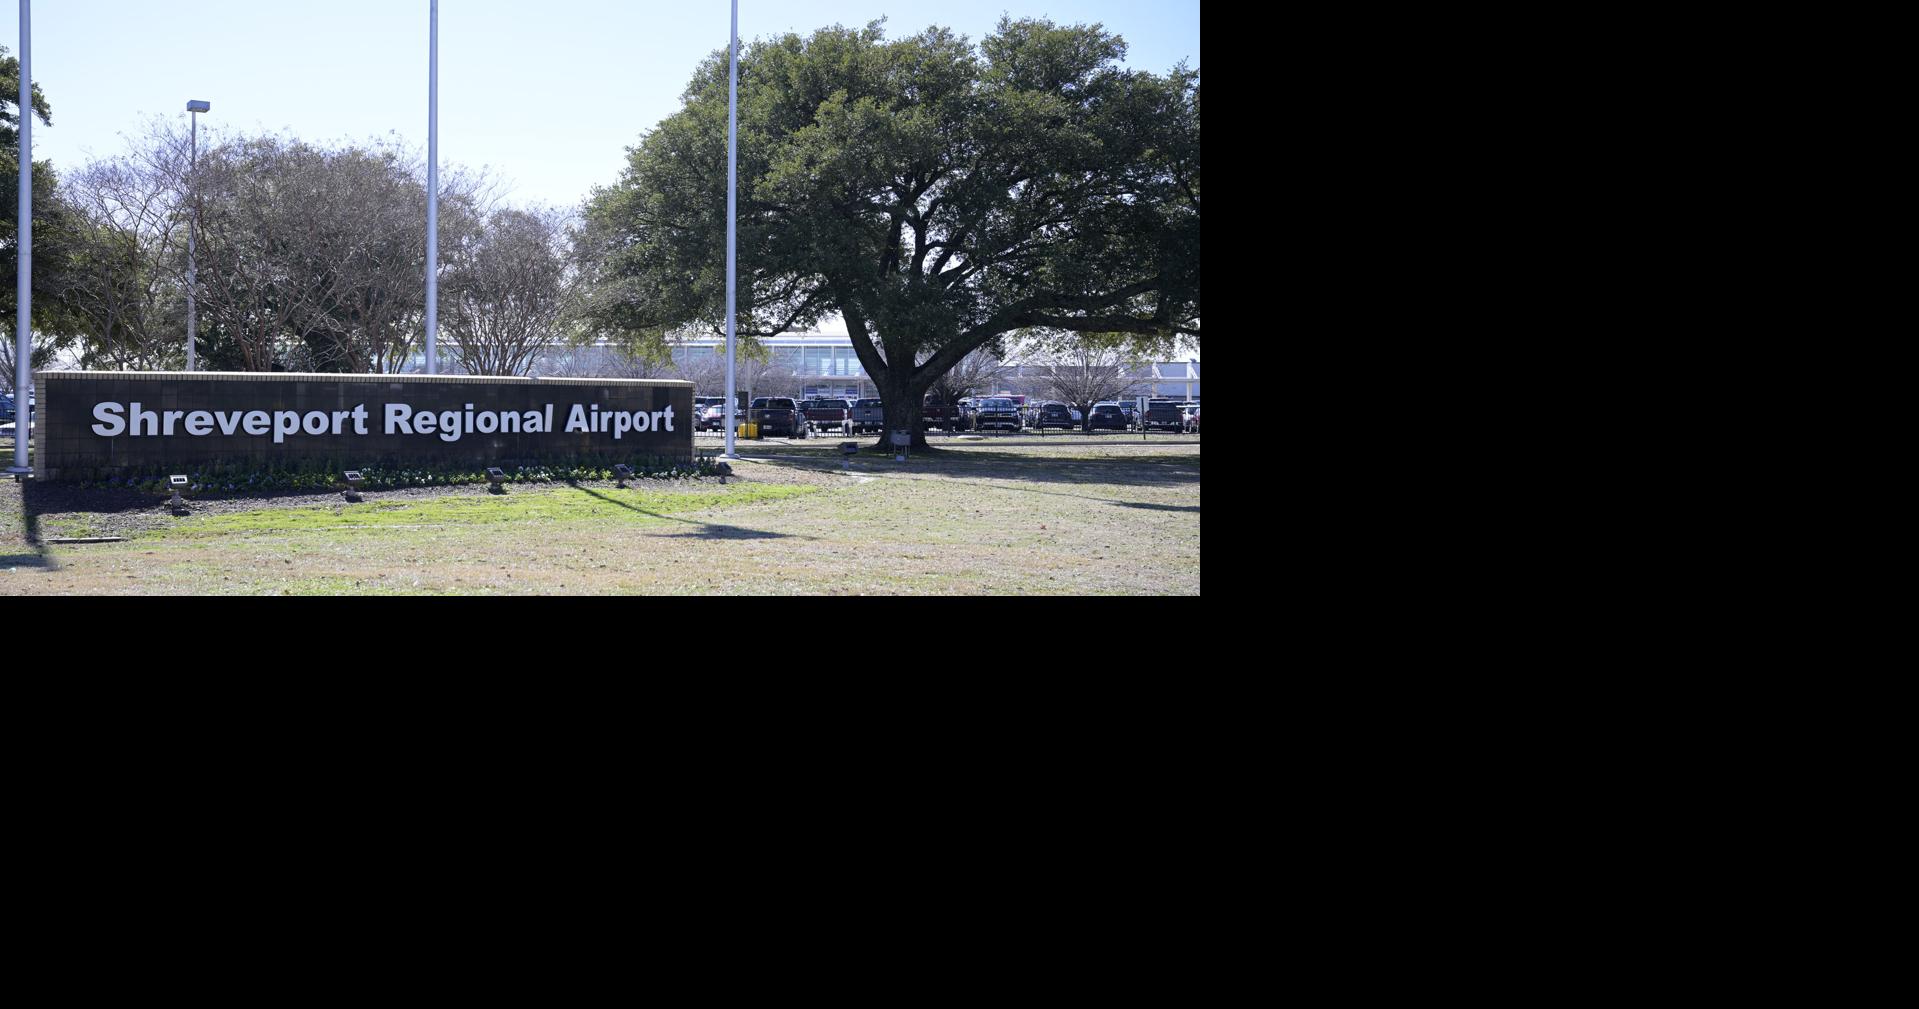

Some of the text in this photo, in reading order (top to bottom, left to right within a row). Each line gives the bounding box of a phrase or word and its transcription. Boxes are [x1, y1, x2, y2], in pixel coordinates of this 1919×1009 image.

[91, 402, 675, 442] Shreveport Regional Airport
